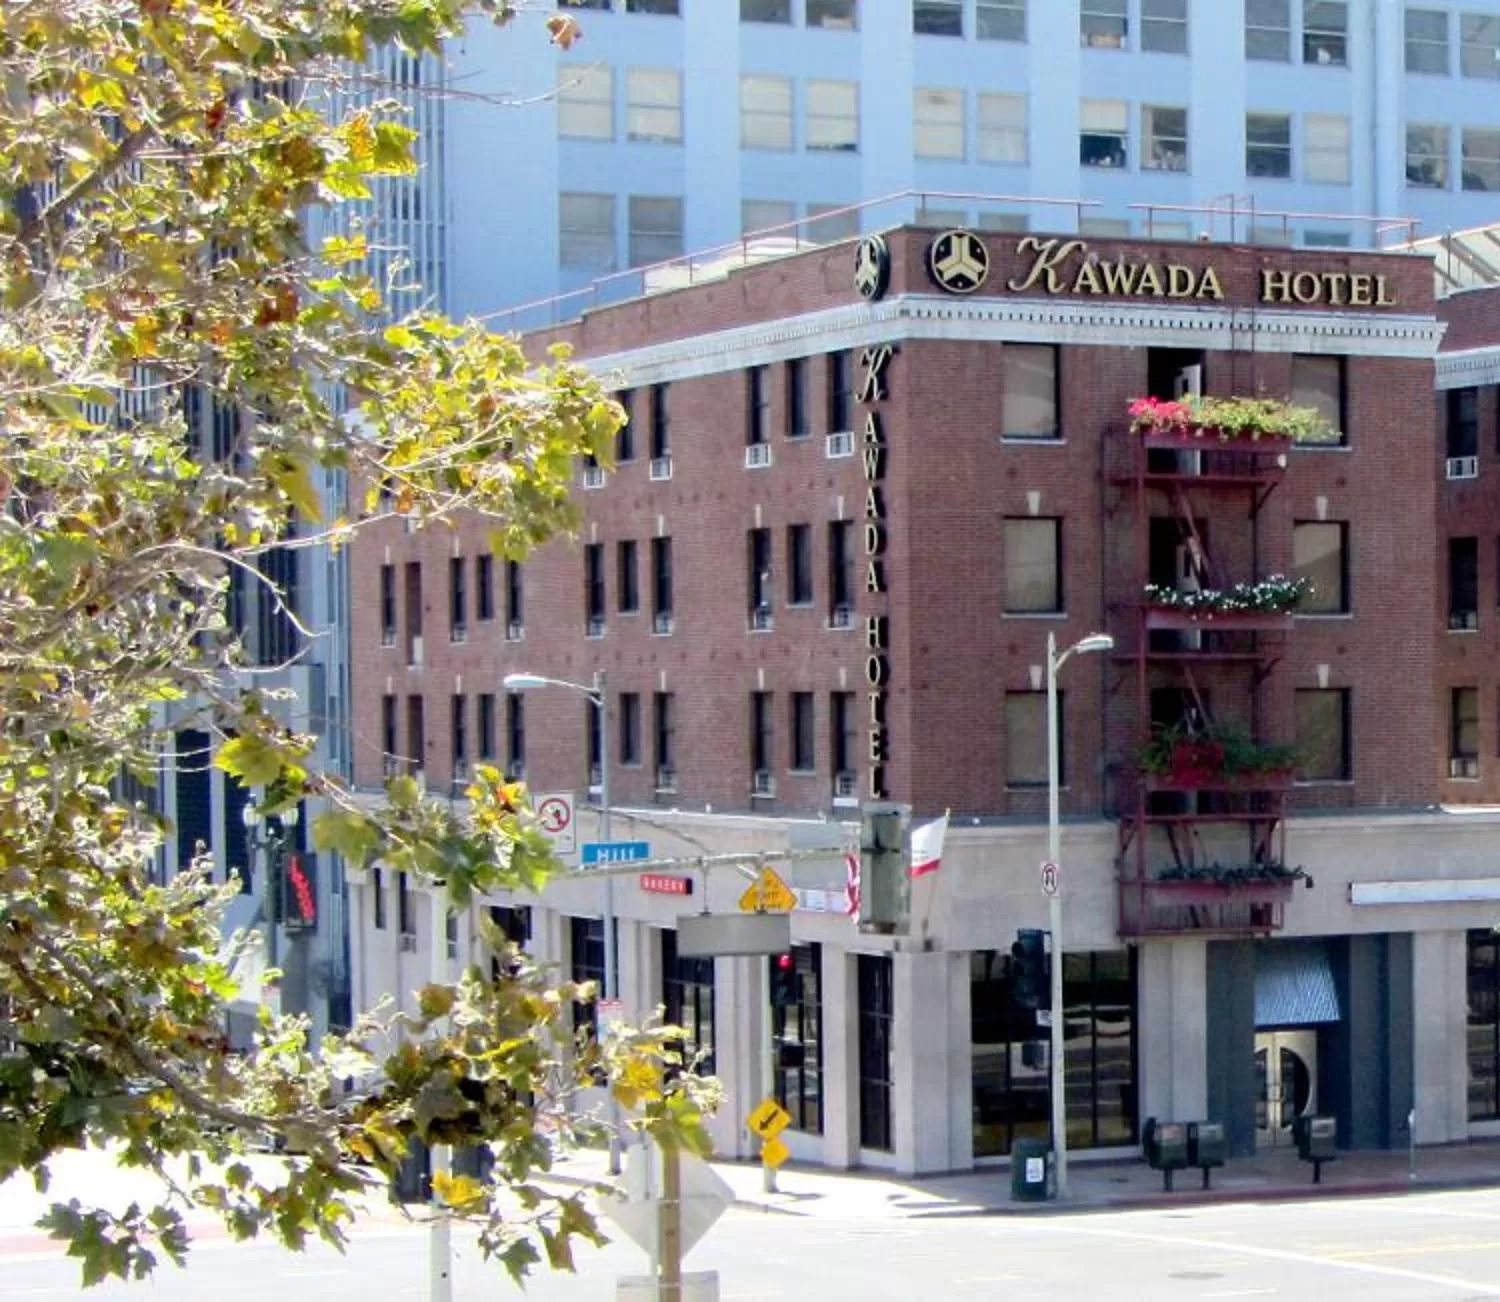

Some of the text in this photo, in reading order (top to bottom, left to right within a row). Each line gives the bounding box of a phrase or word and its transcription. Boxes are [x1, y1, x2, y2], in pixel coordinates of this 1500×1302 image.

[1008, 236, 1397, 305] KAWADA HOTEL
[855, 345, 892, 798] KAWADA HOTEL
